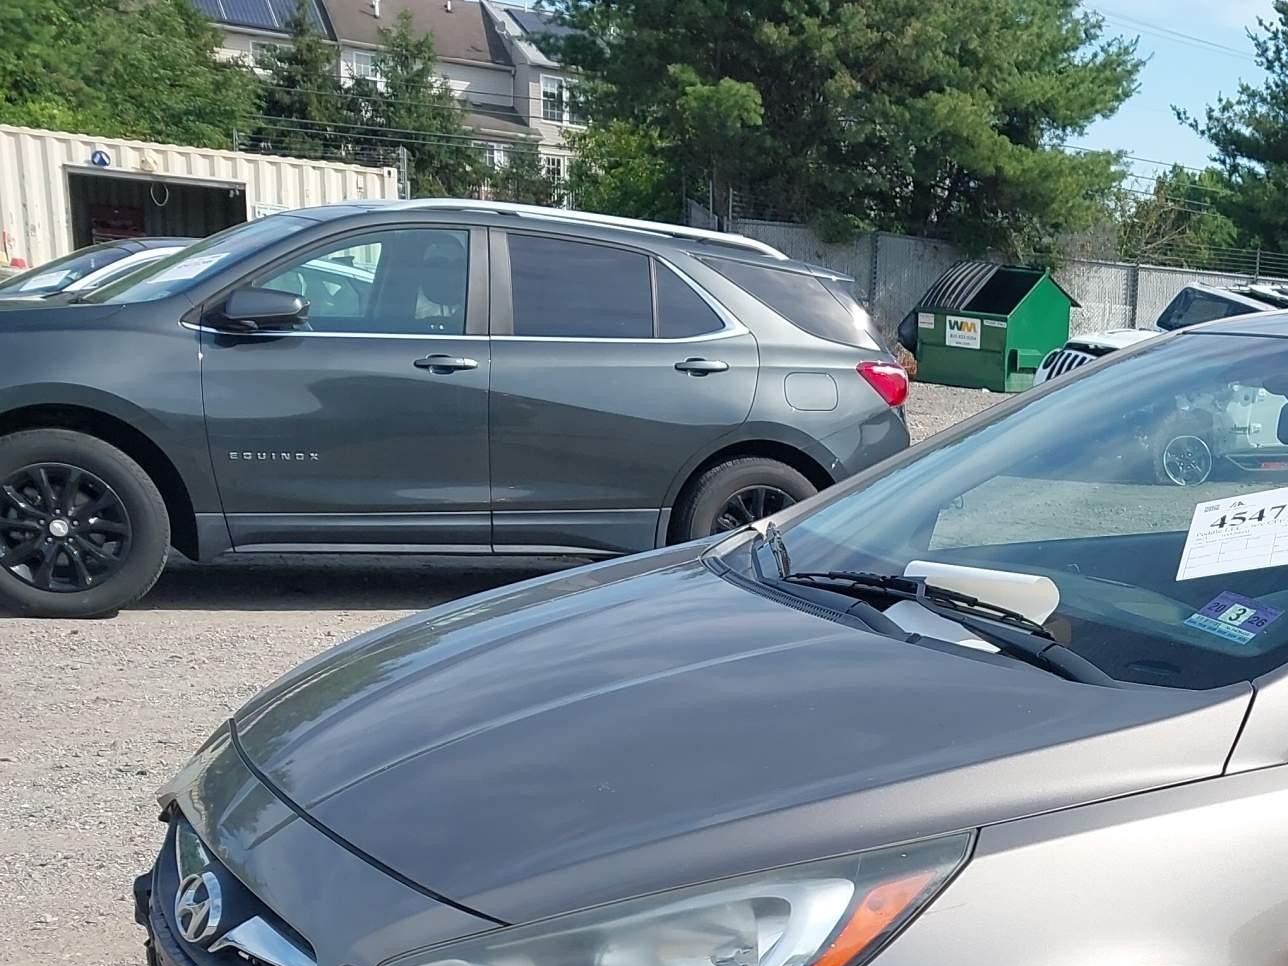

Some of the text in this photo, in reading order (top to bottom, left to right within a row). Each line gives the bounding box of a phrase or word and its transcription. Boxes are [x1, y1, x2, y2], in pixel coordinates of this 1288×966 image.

[949, 320, 976, 333] WM
[229, 451, 319, 461] EQUINOX
[1208, 602, 1267, 628] 20 3 26
